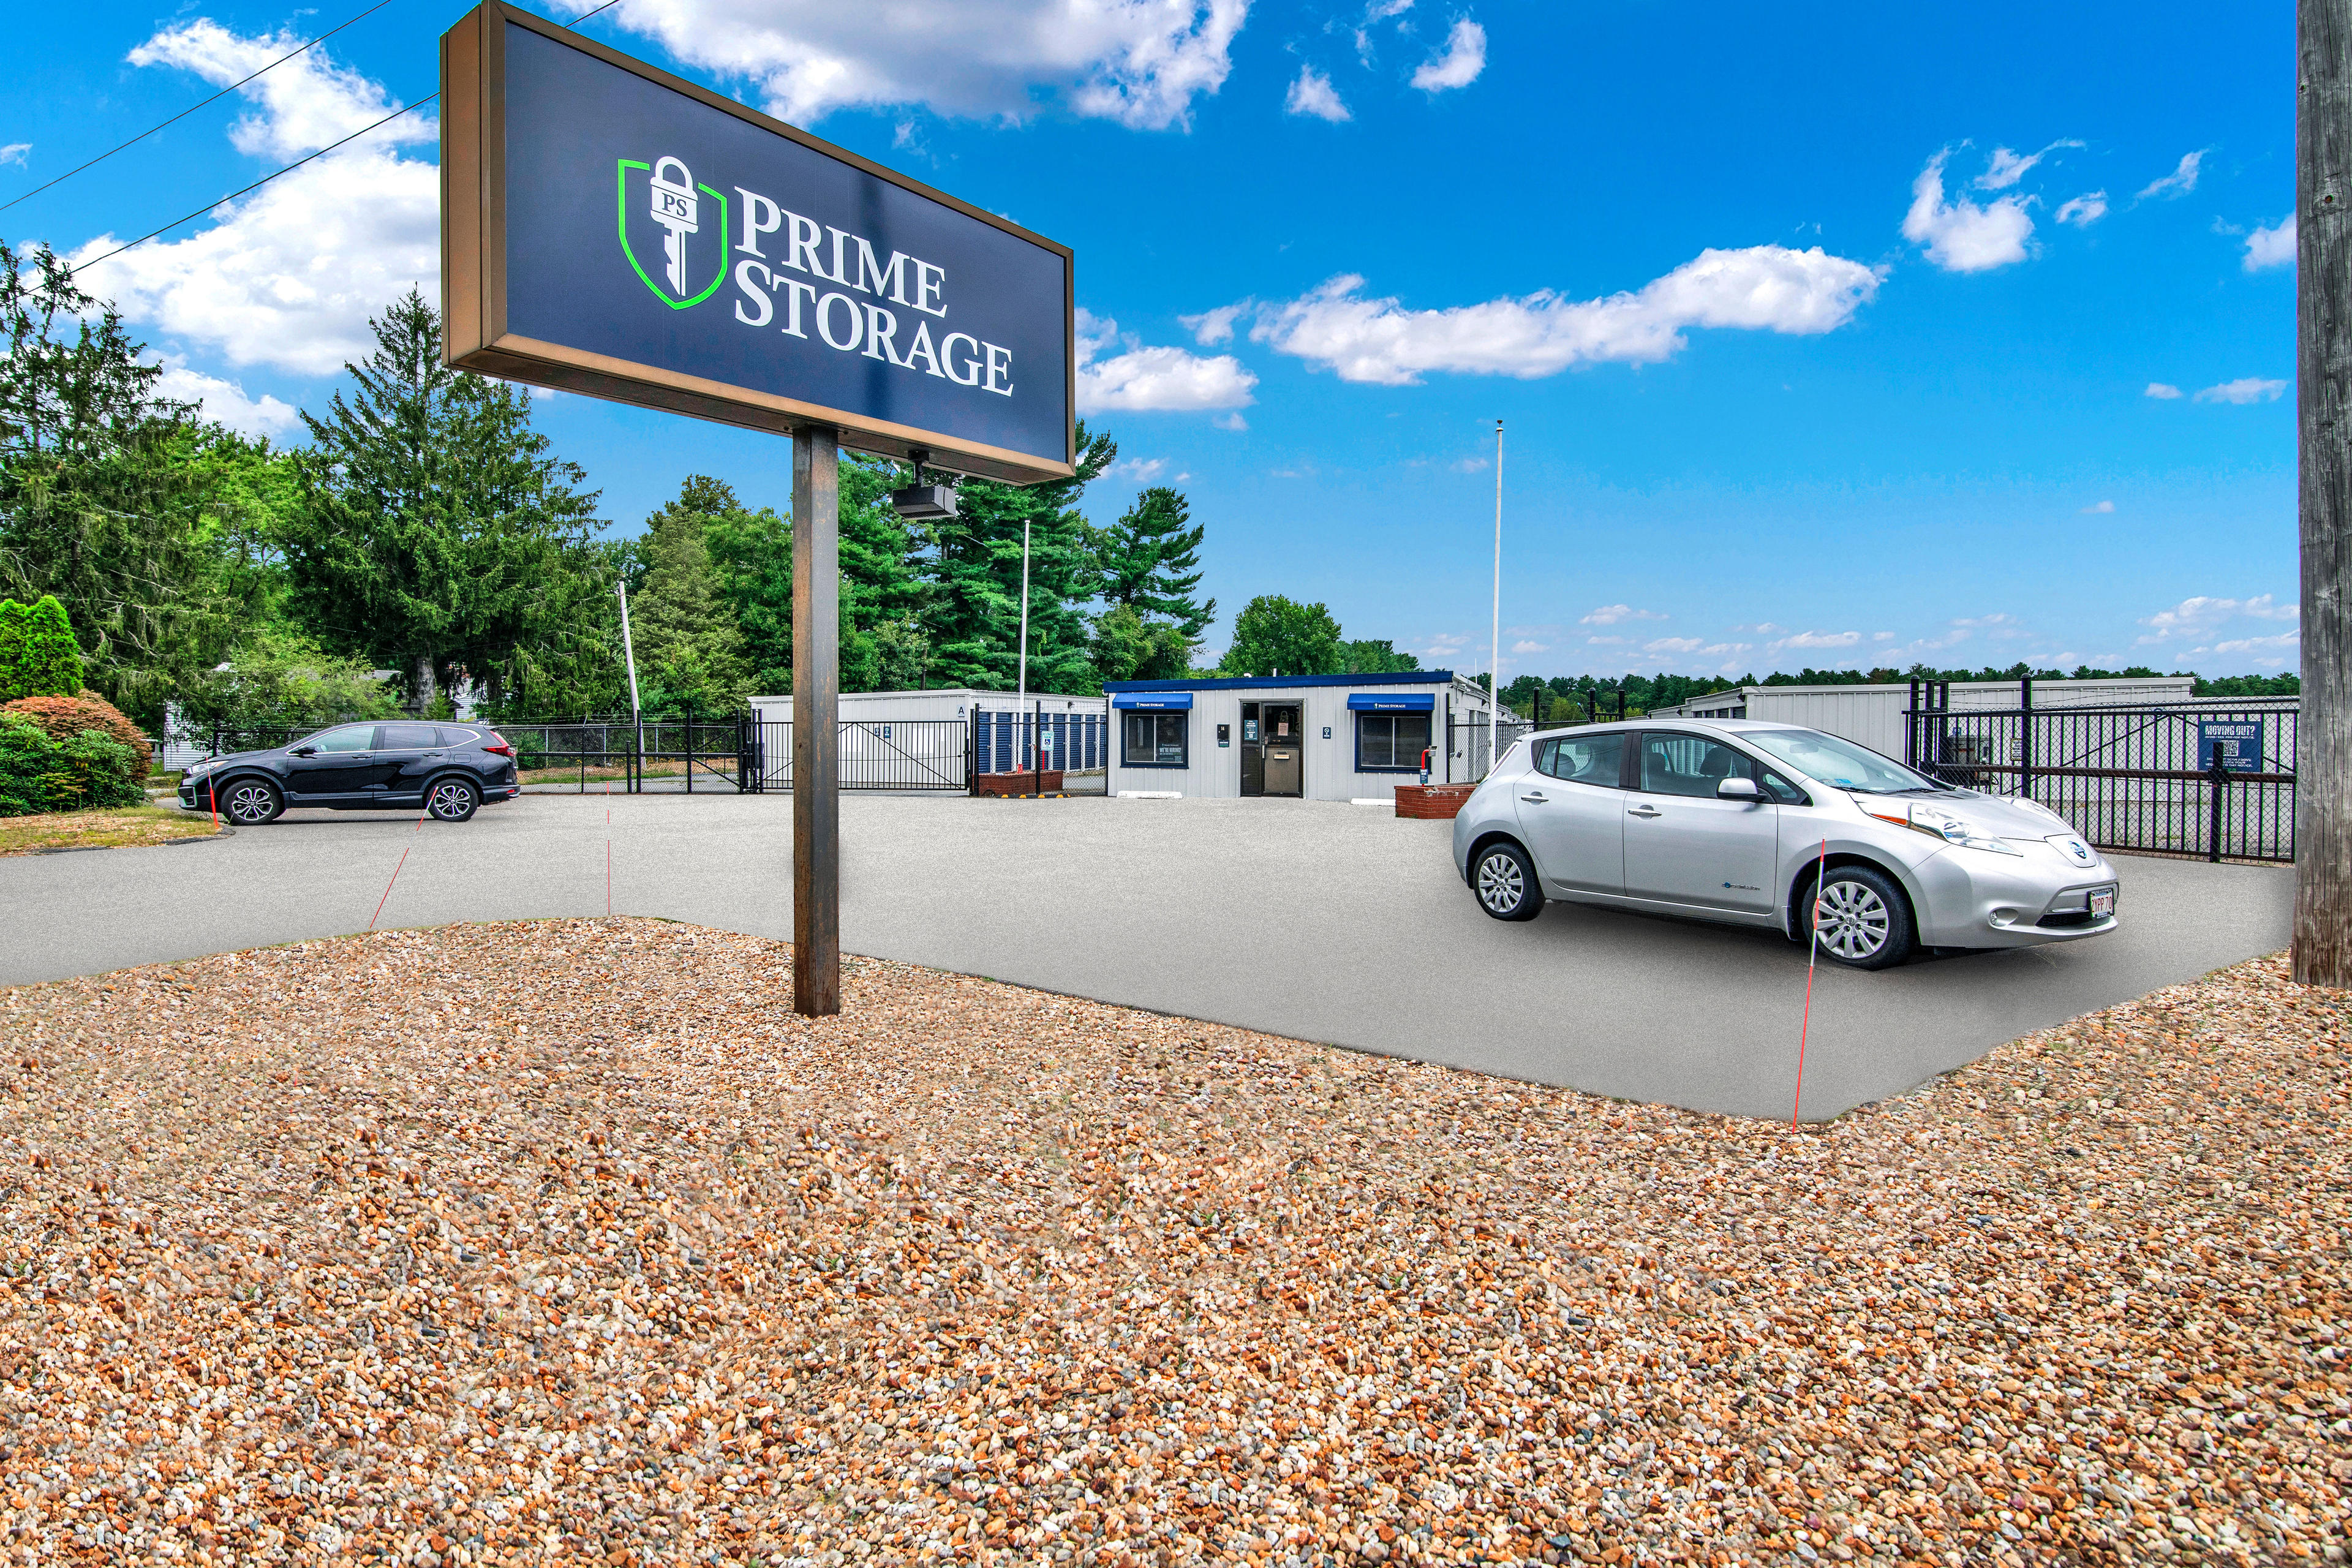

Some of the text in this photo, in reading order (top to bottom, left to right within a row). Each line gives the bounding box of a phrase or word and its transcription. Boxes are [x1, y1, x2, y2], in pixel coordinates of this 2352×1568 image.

[662, 192, 687, 217] PS
[735, 186, 948, 318] PRIME
[735, 260, 1014, 397] STORAGE
[2205, 725, 2256, 736] MOVING OUT?
